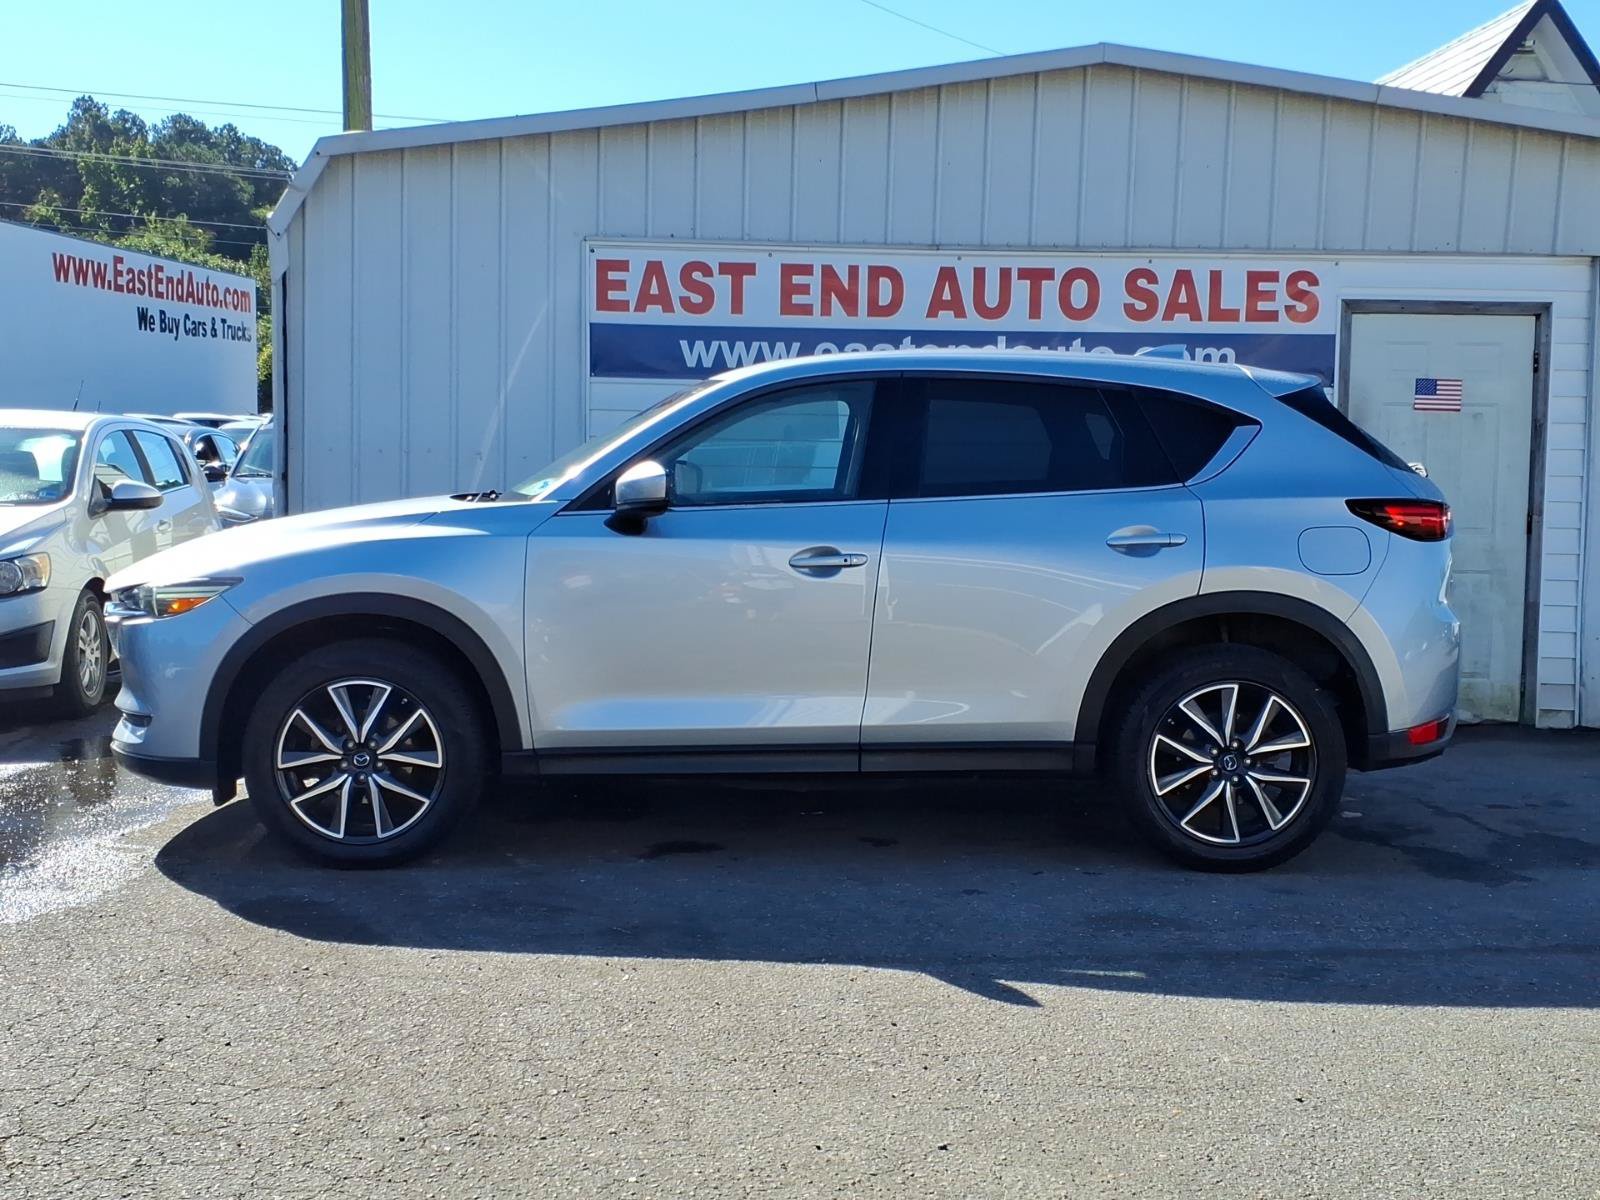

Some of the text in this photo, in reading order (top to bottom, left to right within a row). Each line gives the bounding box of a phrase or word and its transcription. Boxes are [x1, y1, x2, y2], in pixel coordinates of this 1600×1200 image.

[595, 259, 1321, 324] EAST END AUTO SALES
[136, 306, 156, 332] We
[159, 309, 180, 341] Buy
[183, 313, 207, 338] Cars
[210, 316, 218, 339] &
